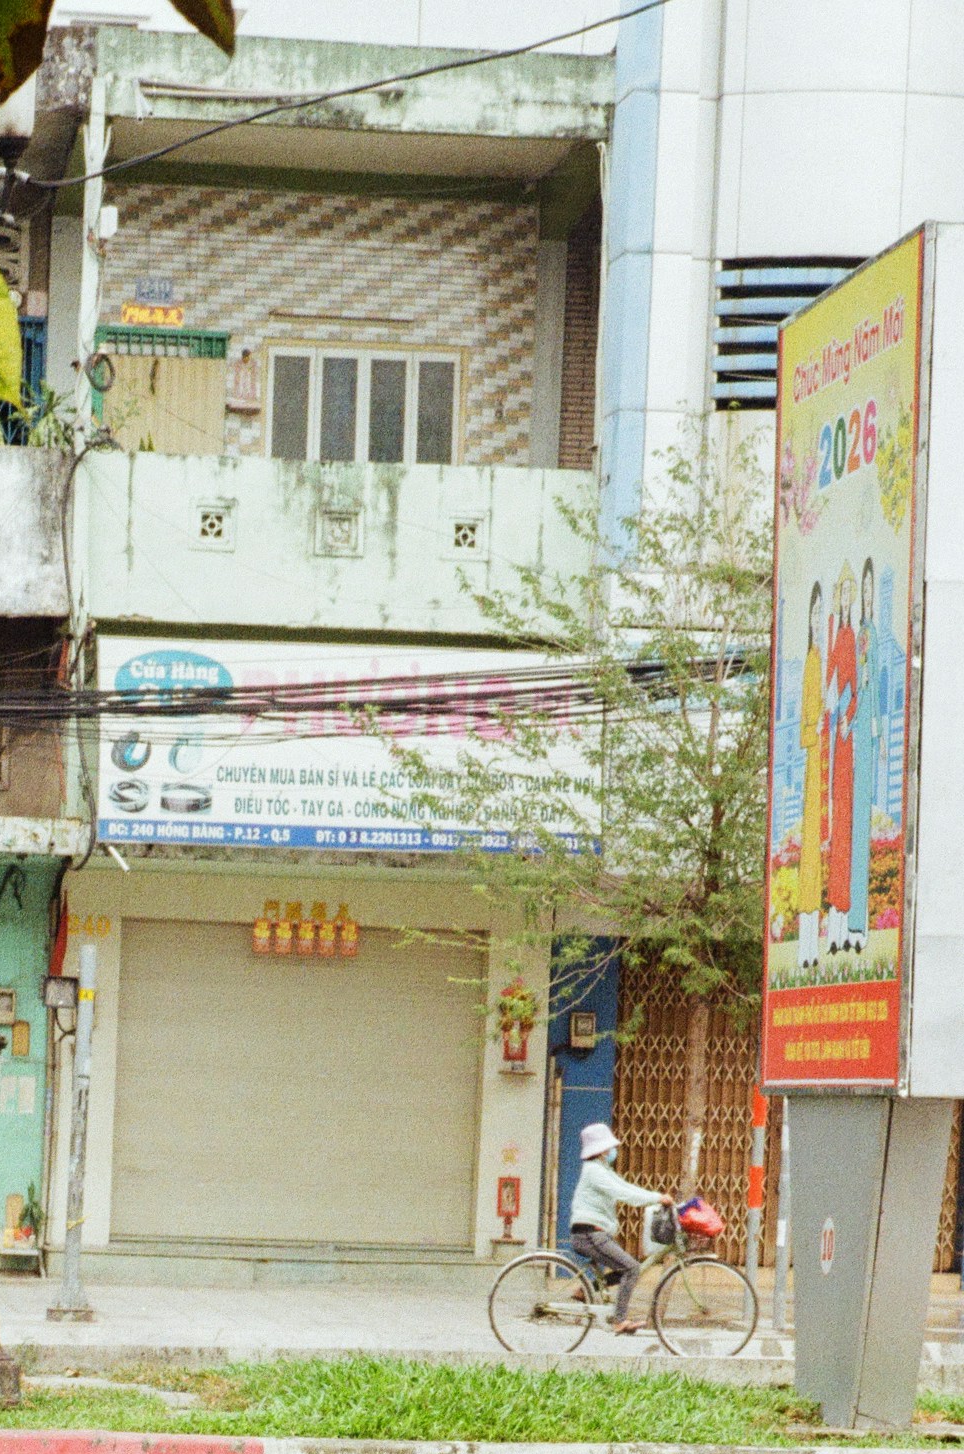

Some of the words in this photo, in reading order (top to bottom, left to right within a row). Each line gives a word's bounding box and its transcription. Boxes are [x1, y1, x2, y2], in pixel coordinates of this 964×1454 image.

[793, 351, 820, 403] Chúc
[821, 338, 852, 386] Mừng
[854, 318, 881, 368] Năm
[883, 294, 905, 350] Mới
[818, 398, 878, 491] 2026
[129, 659, 166, 679] Cửa
[171, 660, 219, 684] Hàng
[216, 763, 267, 783] CHUYÊN
[269, 767, 296, 785] MUA
[300, 799, 325, 816] TAY
[327, 800, 344, 818] GA
[132, 823, 154, 837] 240
[234, 827, 261, 840] P.12
[270, 828, 291, 843] Q.5
[315, 829, 336, 842] ĐT:
